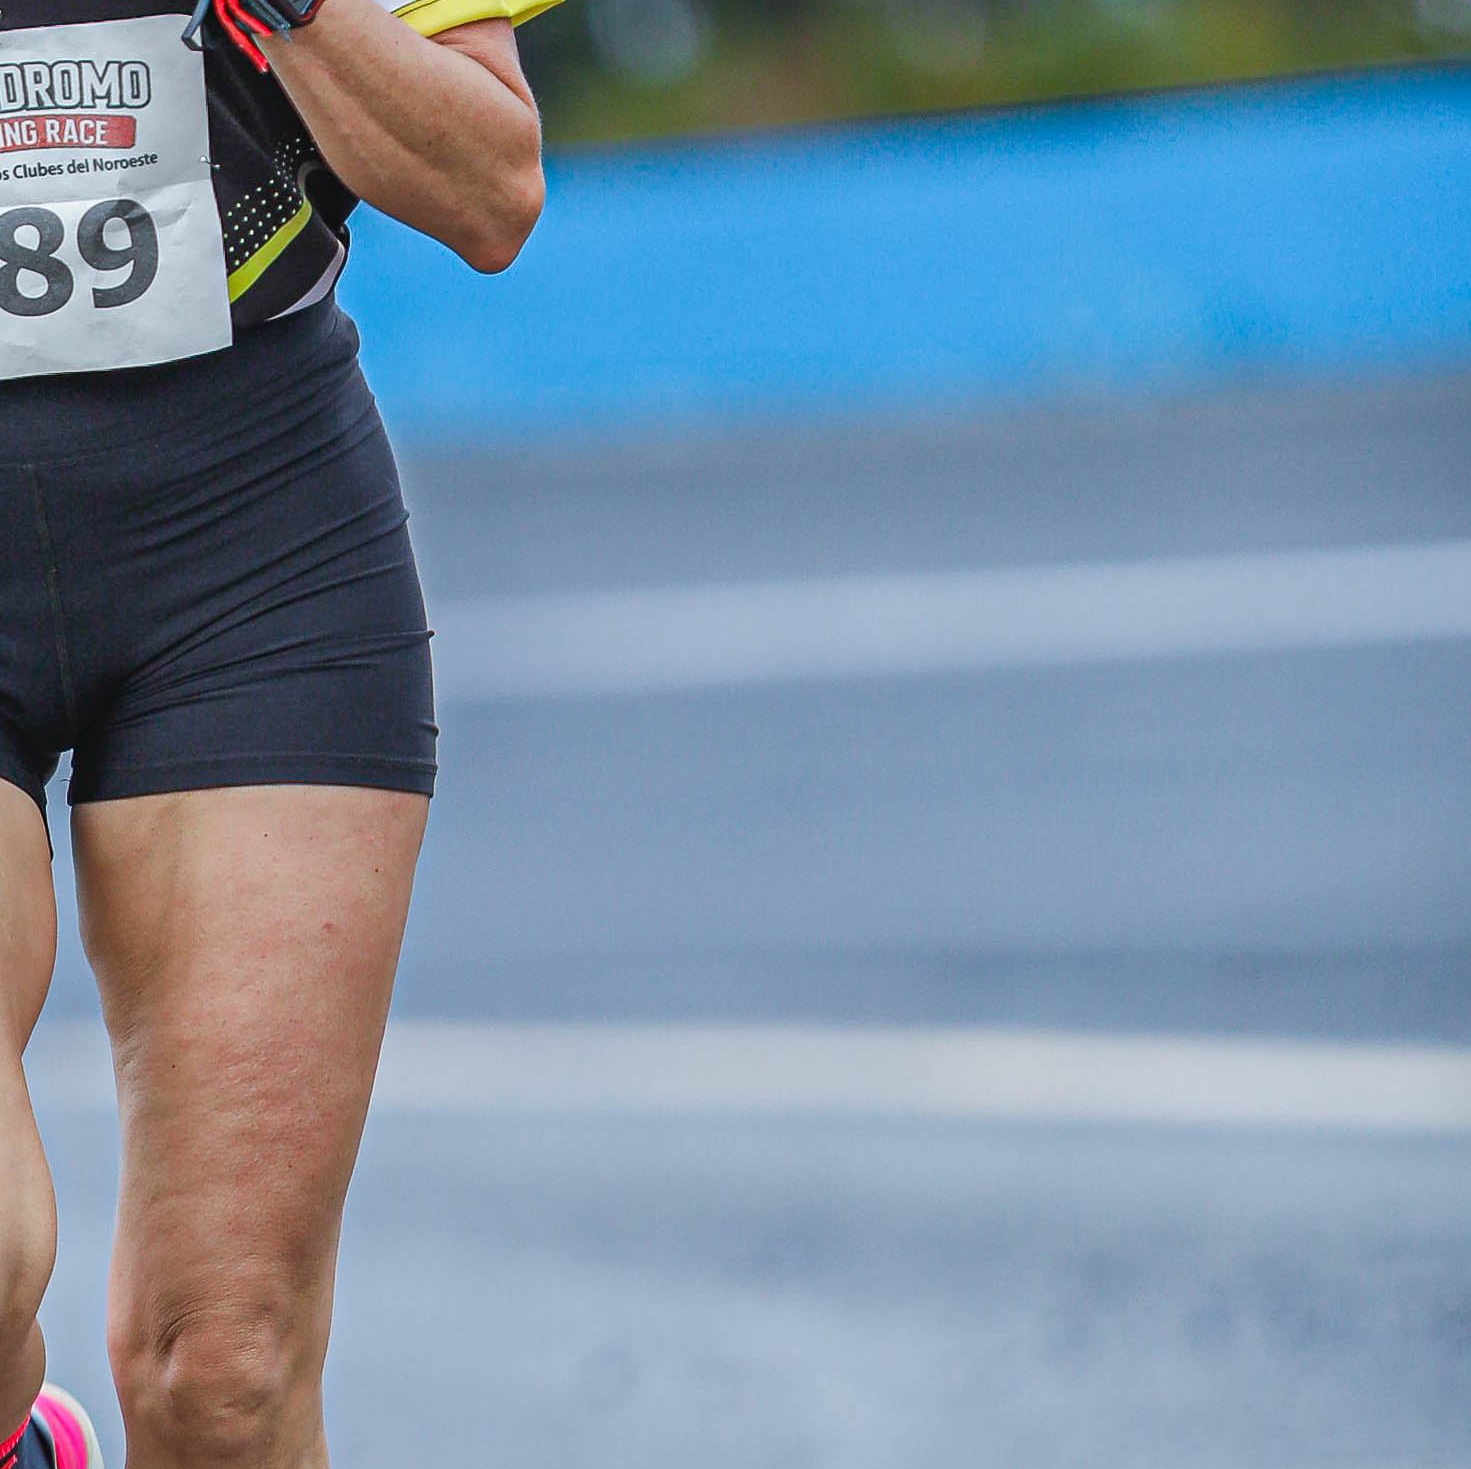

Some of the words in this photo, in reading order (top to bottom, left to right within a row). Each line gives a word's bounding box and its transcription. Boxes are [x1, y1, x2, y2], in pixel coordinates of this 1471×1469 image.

[45, 119, 109, 145] RACE
[12, 162, 64, 179] Clubes
[67, 158, 90, 174] del
[93, 152, 159, 172] Noroeste
